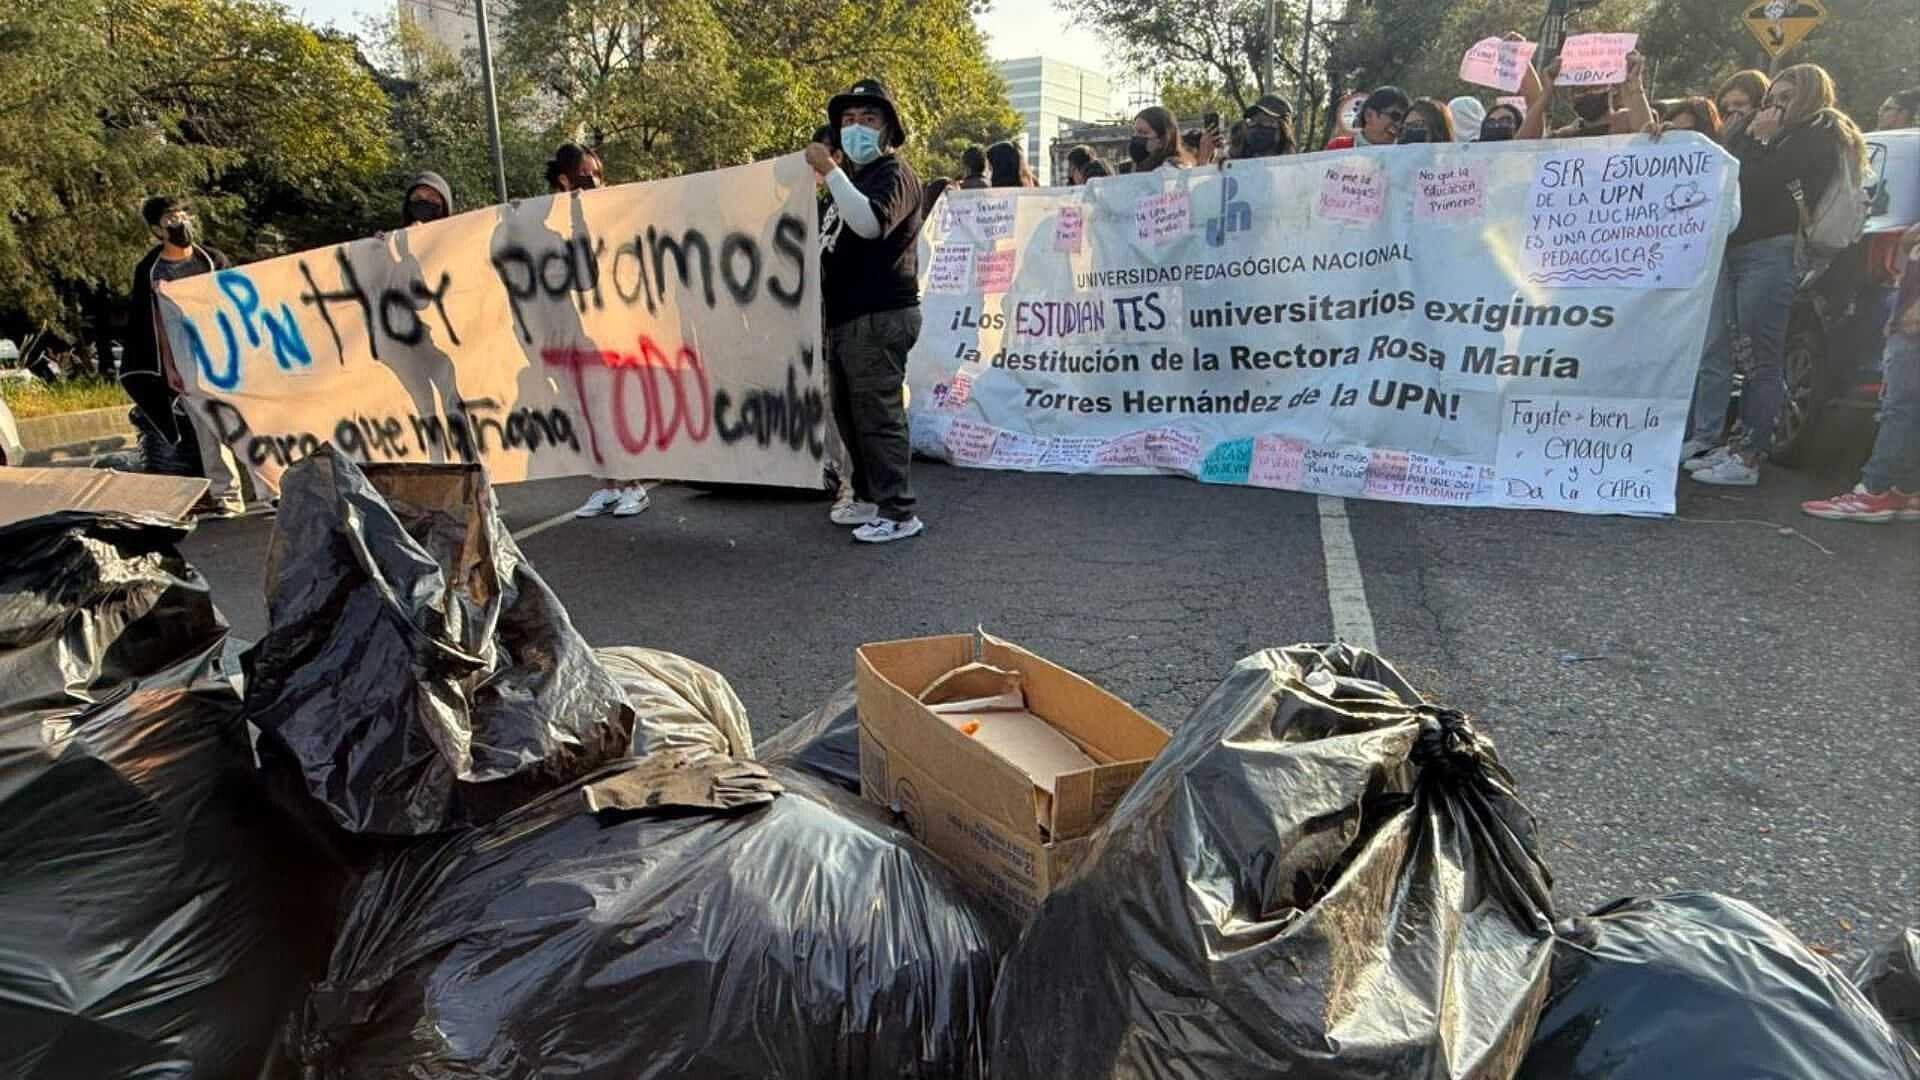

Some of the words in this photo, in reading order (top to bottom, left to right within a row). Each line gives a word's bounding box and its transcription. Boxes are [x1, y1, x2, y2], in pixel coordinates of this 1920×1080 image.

[1541, 157, 1586, 189] SER
[1601, 150, 1714, 183] ESTUDIANTE
[1536, 193, 1557, 209] DE
[1568, 190, 1590, 207] LA
[1599, 183, 1645, 205] UPN
[1548, 211, 1578, 230] NO
[1588, 203, 1661, 226] LUCHAR
[1525, 235, 1546, 251] ES
[1553, 232, 1586, 248] UNA
[1590, 217, 1705, 245] CONTRADICCIÓN
[1077, 263, 1182, 290] UNIVERSIDAD
[1185, 254, 1307, 282] PEDAGÓGICA
[1312, 243, 1414, 272] NACIONAL
[183, 269, 314, 391] UPN
[492, 212, 808, 345] paramos
[951, 306, 1005, 333] ¡Los
[1190, 289, 1416, 329] universitarios
[1424, 299, 1615, 333] exigimos
[955, 342, 982, 363] la
[991, 348, 1140, 374] destitución
[1151, 347, 1184, 372] de
[1193, 346, 1220, 372] la
[1231, 341, 1361, 371] Rectora
[1368, 335, 1447, 370] Rosa
[1461, 345, 1580, 379] María
[541, 334, 712, 470] TODO
[1024, 387, 1112, 414] Torres
[1124, 387, 1285, 415] Hernández
[1287, 386, 1321, 410] de
[1330, 383, 1357, 408] la
[1367, 378, 1461, 421] UPN!
[1643, 406, 1661, 429] la
